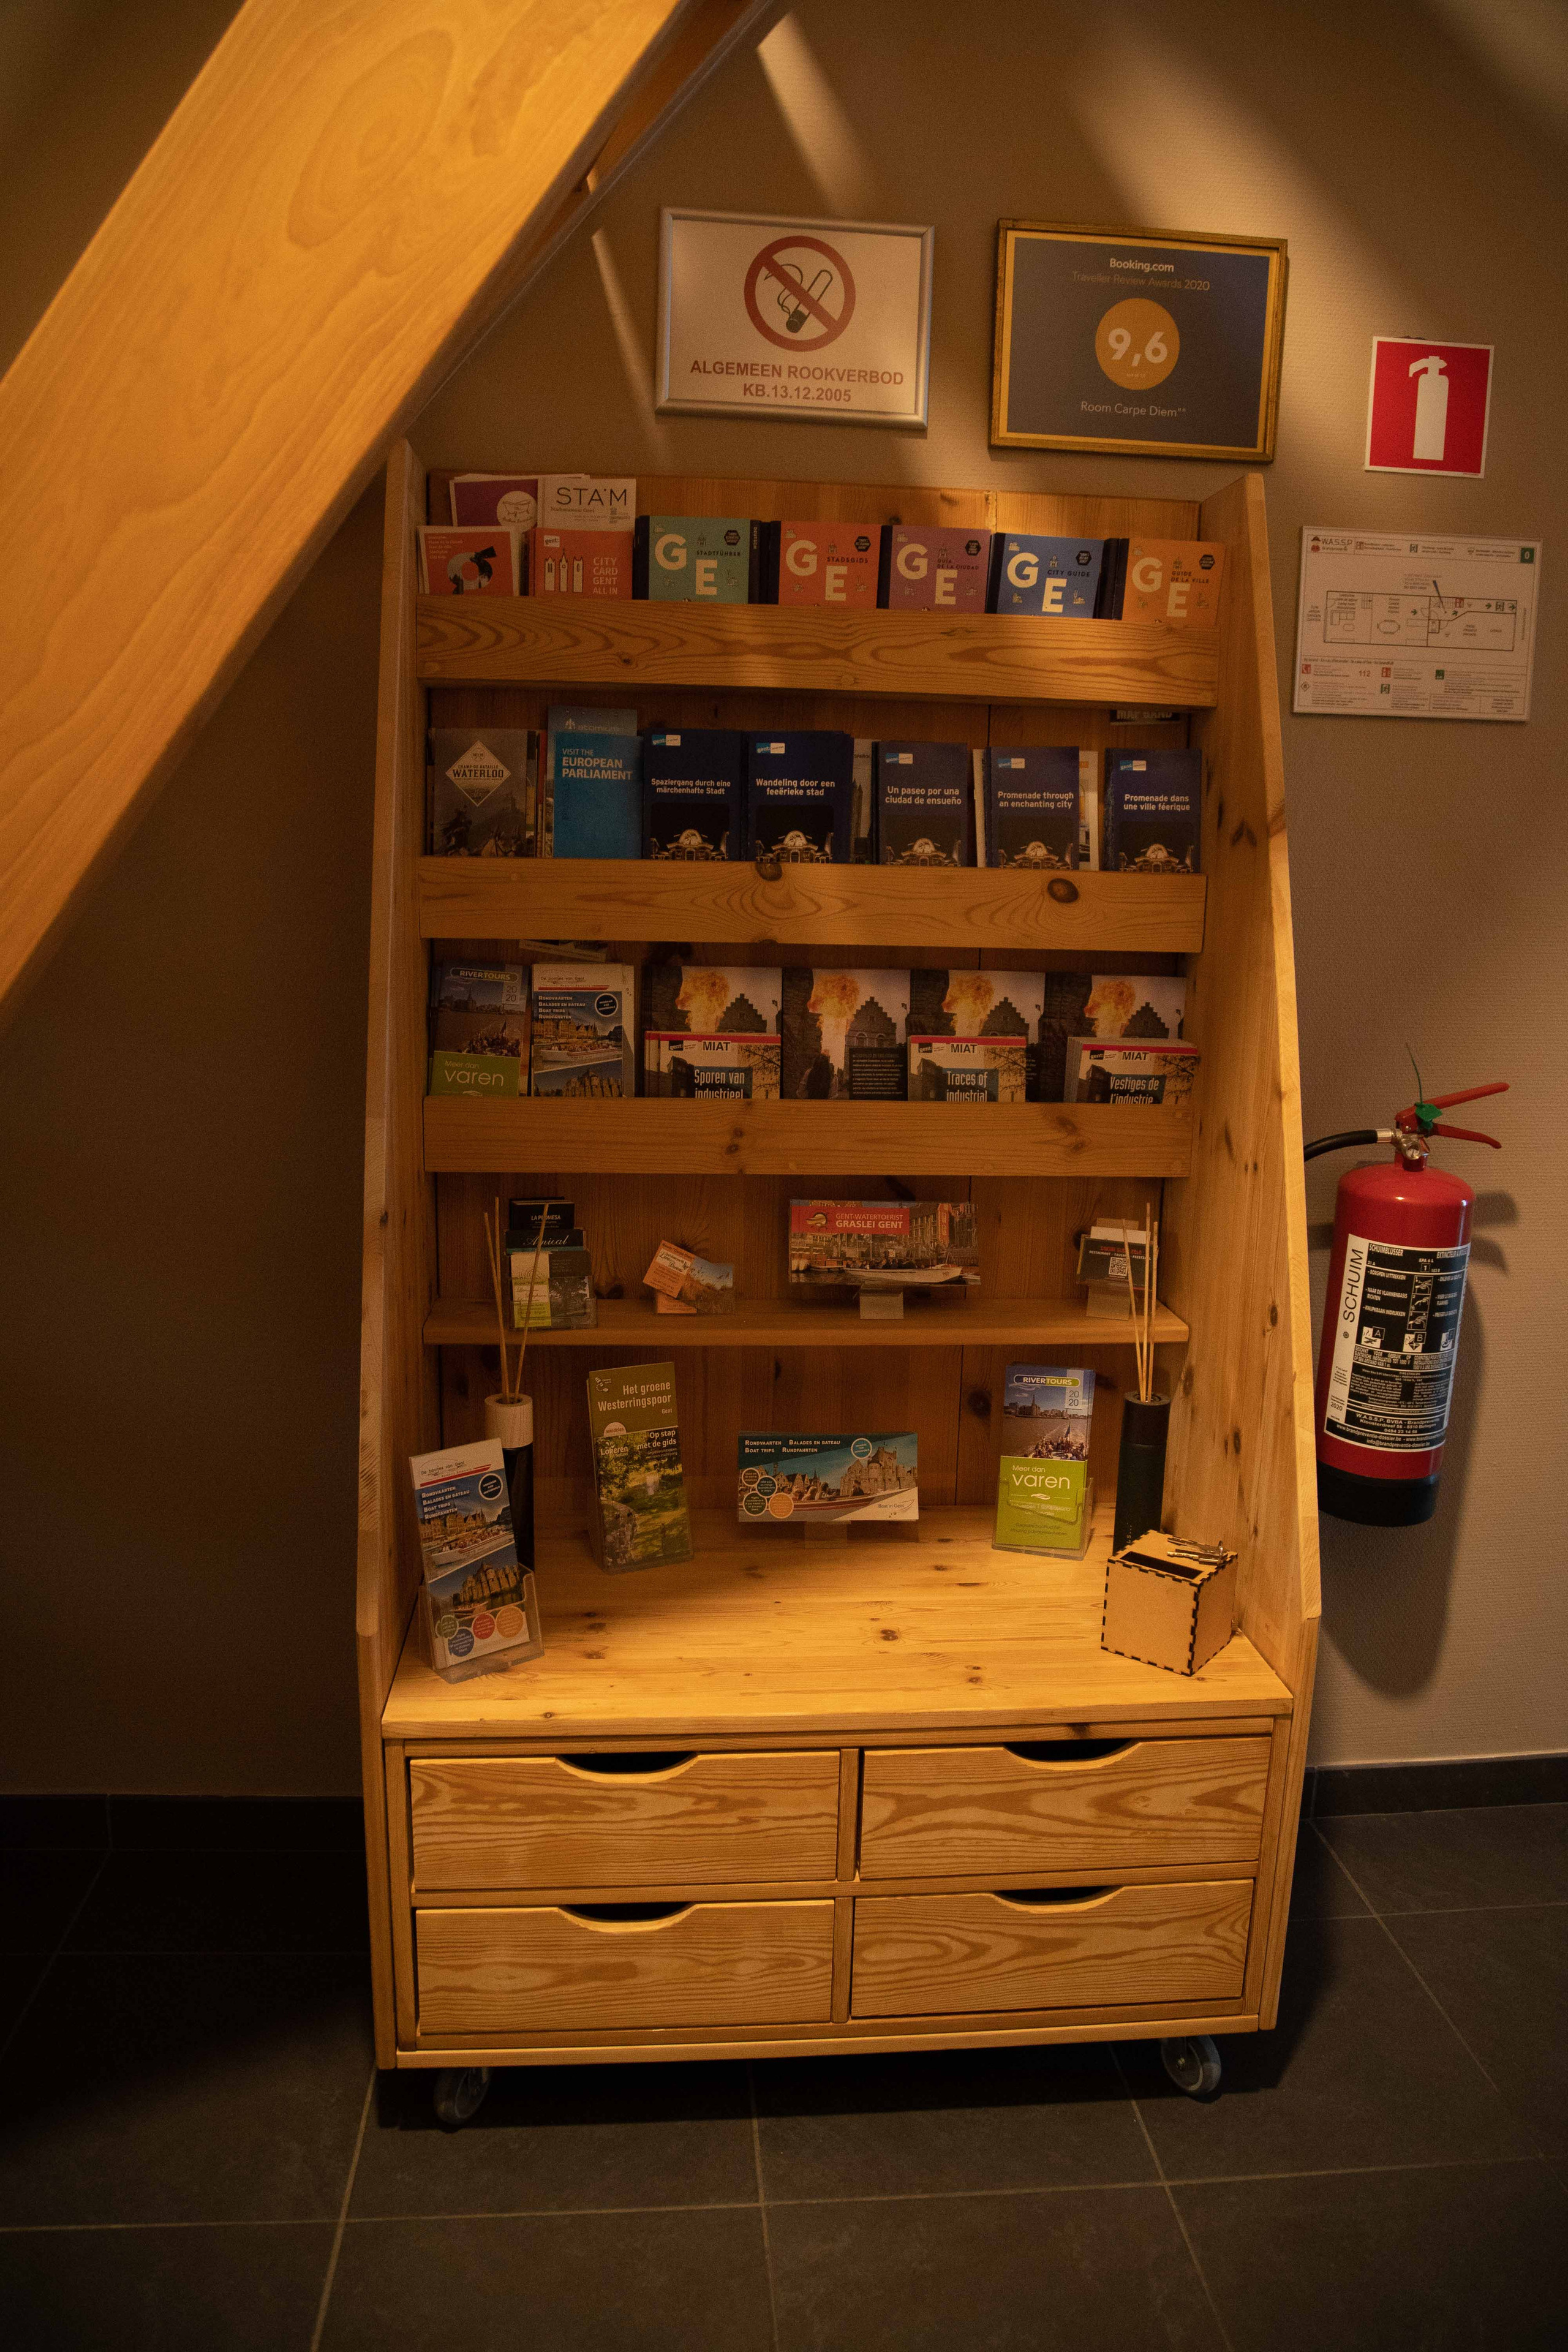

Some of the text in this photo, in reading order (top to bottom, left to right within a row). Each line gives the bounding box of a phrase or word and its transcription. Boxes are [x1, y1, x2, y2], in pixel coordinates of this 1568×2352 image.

[1109, 258, 1174, 273] Booking.com
[1073, 271, 1210, 291] Traveller Review Awards 2020
[1108, 328, 1168, 367] 9,6
[690, 360, 904, 385] ALGEMEEN ROOKVERBOD
[743, 383, 852, 402] KB.13.12.2005
[1080, 401, 1147, 417] Room Carpe
[592, 557, 617, 566] CITY
[592, 567, 619, 576] CARD
[592, 576, 618, 585] GENT
[592, 586, 619, 595] ALL IN
[581, 748, 594, 757] THE
[562, 756, 623, 769] EUROPEAN
[452, 769, 504, 778] WATERLOO
[562, 767, 633, 781] PARLIAMENT
[651, 778, 693, 787] Spaziergang
[755, 778, 798, 788] Wandeling
[799, 779, 819, 788] door
[766, 787, 825, 796] feeërieke stad
[887, 786, 899, 794] Un
[901, 787, 926, 796] paseo
[927, 788, 941, 797] por
[997, 791, 1074, 801] Promenade through
[884, 795, 913, 804] ciudad
[926, 796, 962, 805] ensueño
[1124, 793, 1169, 802] Promenade
[1010, 800, 1055, 810] enchanting
[1057, 801, 1073, 810] city
[1158, 802, 1191, 812] féerique
[459, 970, 511, 981] RIVERTOURS
[506, 993, 517, 1002] 20
[703, 1041, 731, 1052] MIAT
[951, 1043, 978, 1054] MIAT
[1121, 1051, 1150, 1061] MIAT
[444, 1069, 505, 1087] varen
[694, 1069, 745, 1087] Sporen van
[946, 1071, 989, 1088] Traces of
[1110, 1076, 1160, 1093] Vestiges de
[835, 1213, 904, 1221] GENT-WATERTOERIST
[835, 1219, 903, 1229] GRASLEI GENT
[1369, 1244, 1404, 1257] SCHUIMBLUSSER
[1343, 1248, 1364, 1323] SCHUIM
[1022, 1376, 1072, 1385] RIVERTOURS
[623, 1382, 671, 1395] Het groene
[598, 1395, 672, 1412] Westerringspoor
[1330, 1401, 1343, 1412] 2020
[1355, 1412, 1385, 1423] W.A.S.S.P.
[660, 1430, 676, 1439] stap
[662, 1438, 677, 1448] gids
[1012, 1474, 1070, 1489] varen
